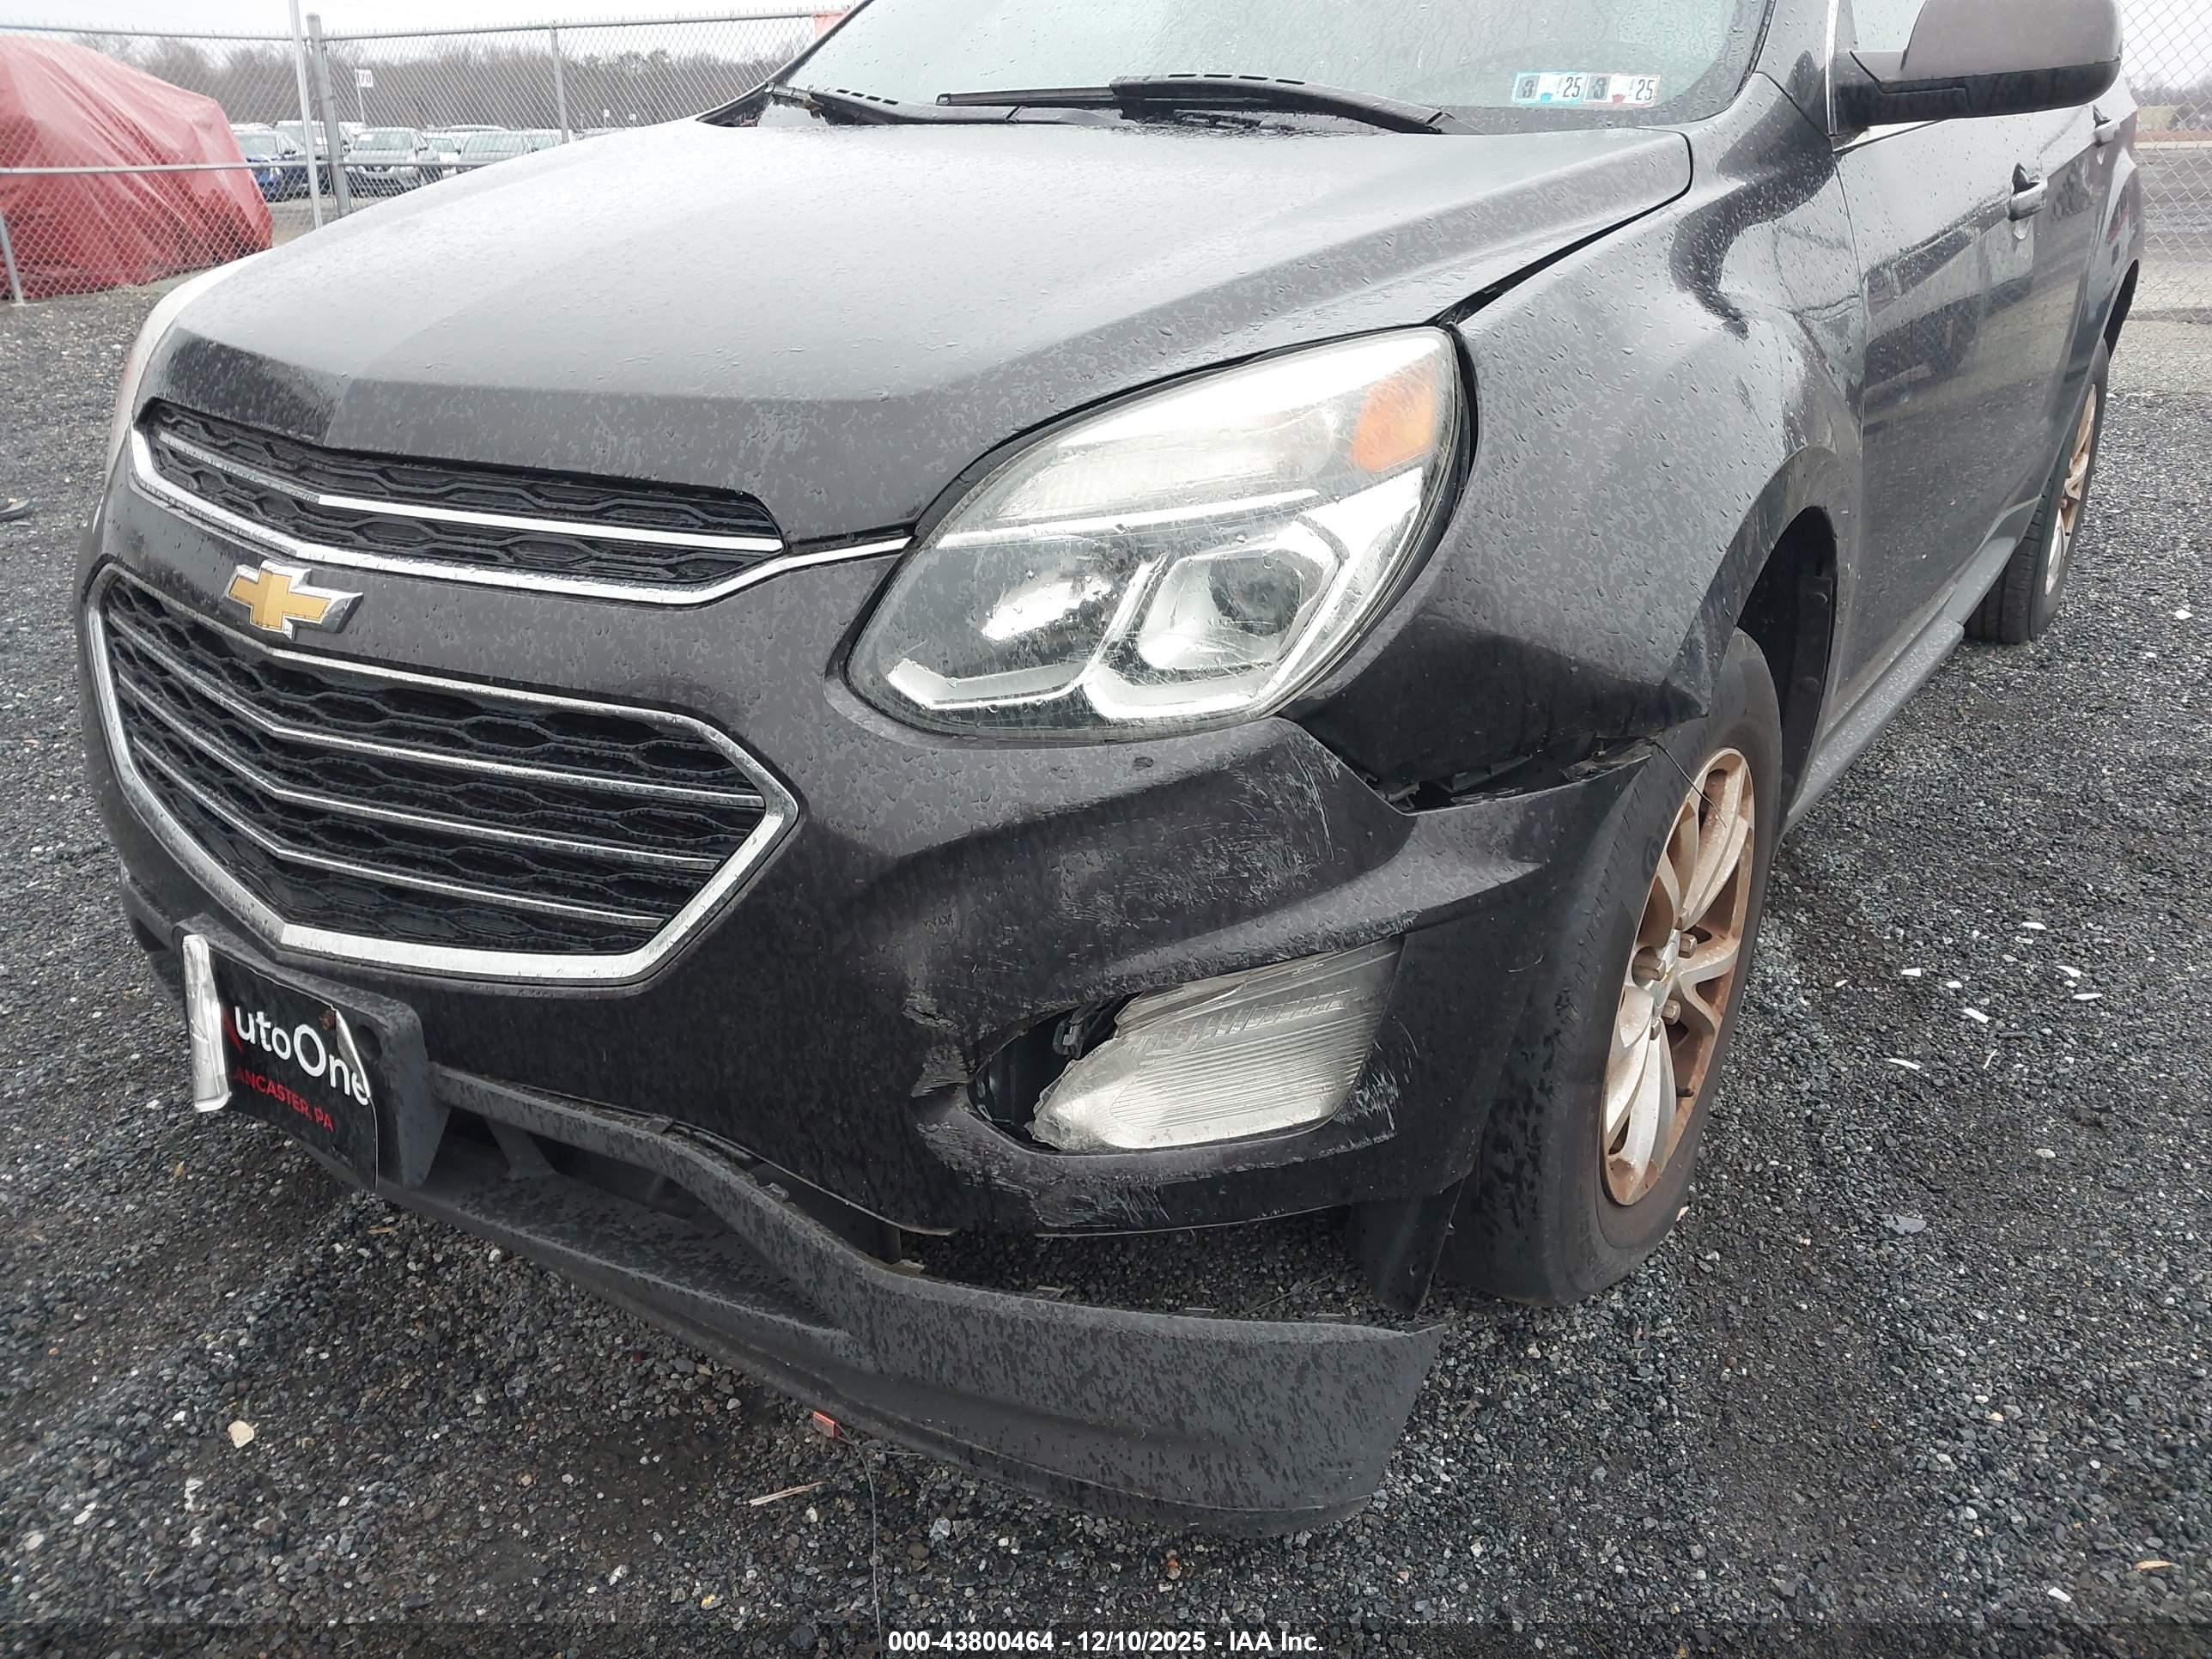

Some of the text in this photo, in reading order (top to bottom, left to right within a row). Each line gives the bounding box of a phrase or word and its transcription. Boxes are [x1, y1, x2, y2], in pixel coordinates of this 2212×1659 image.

[1563, 76, 1583, 98] 25
[1593, 77, 1655, 100] 3 25
[314, 1106, 334, 1133] PA
